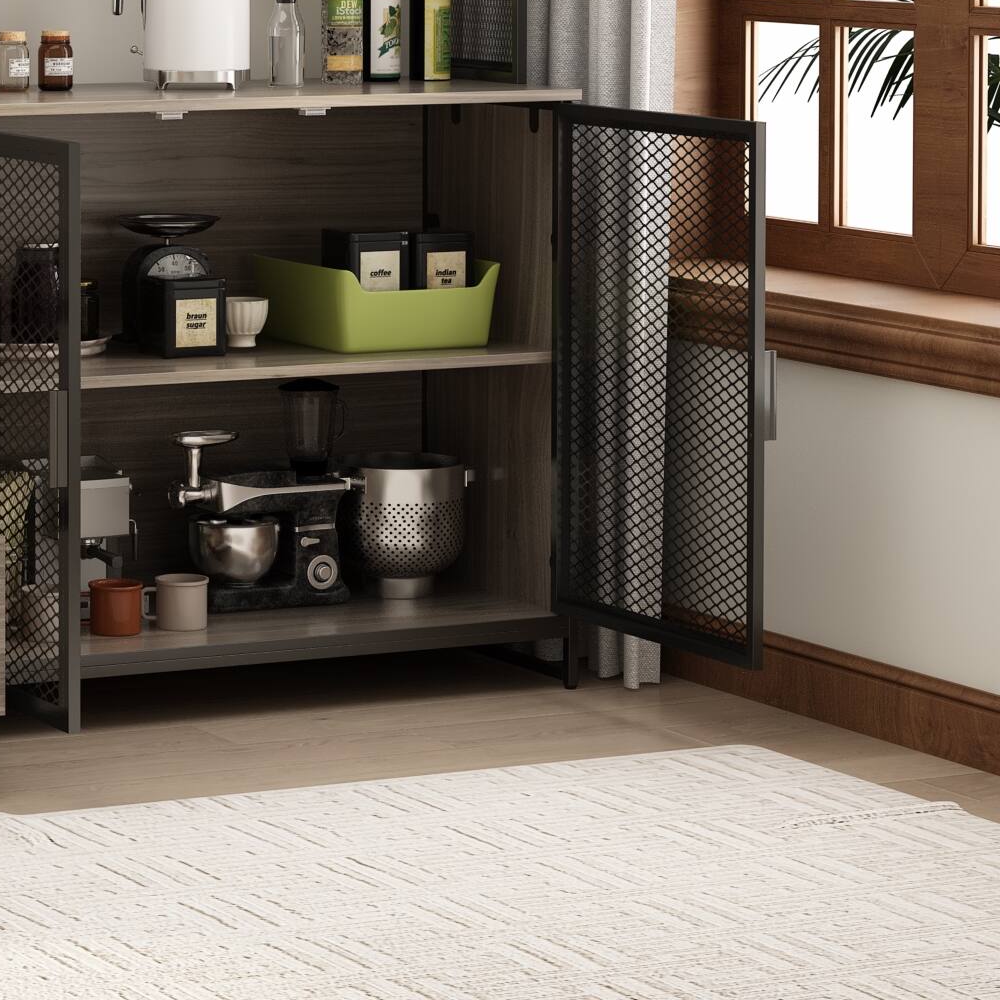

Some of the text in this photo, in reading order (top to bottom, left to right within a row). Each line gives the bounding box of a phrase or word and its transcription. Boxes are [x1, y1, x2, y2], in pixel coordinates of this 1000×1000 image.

[370, 268, 392, 277] coffee
[435, 268, 457, 276] indian
[185, 312, 208, 320] braun
[185, 321, 207, 330] sugar
